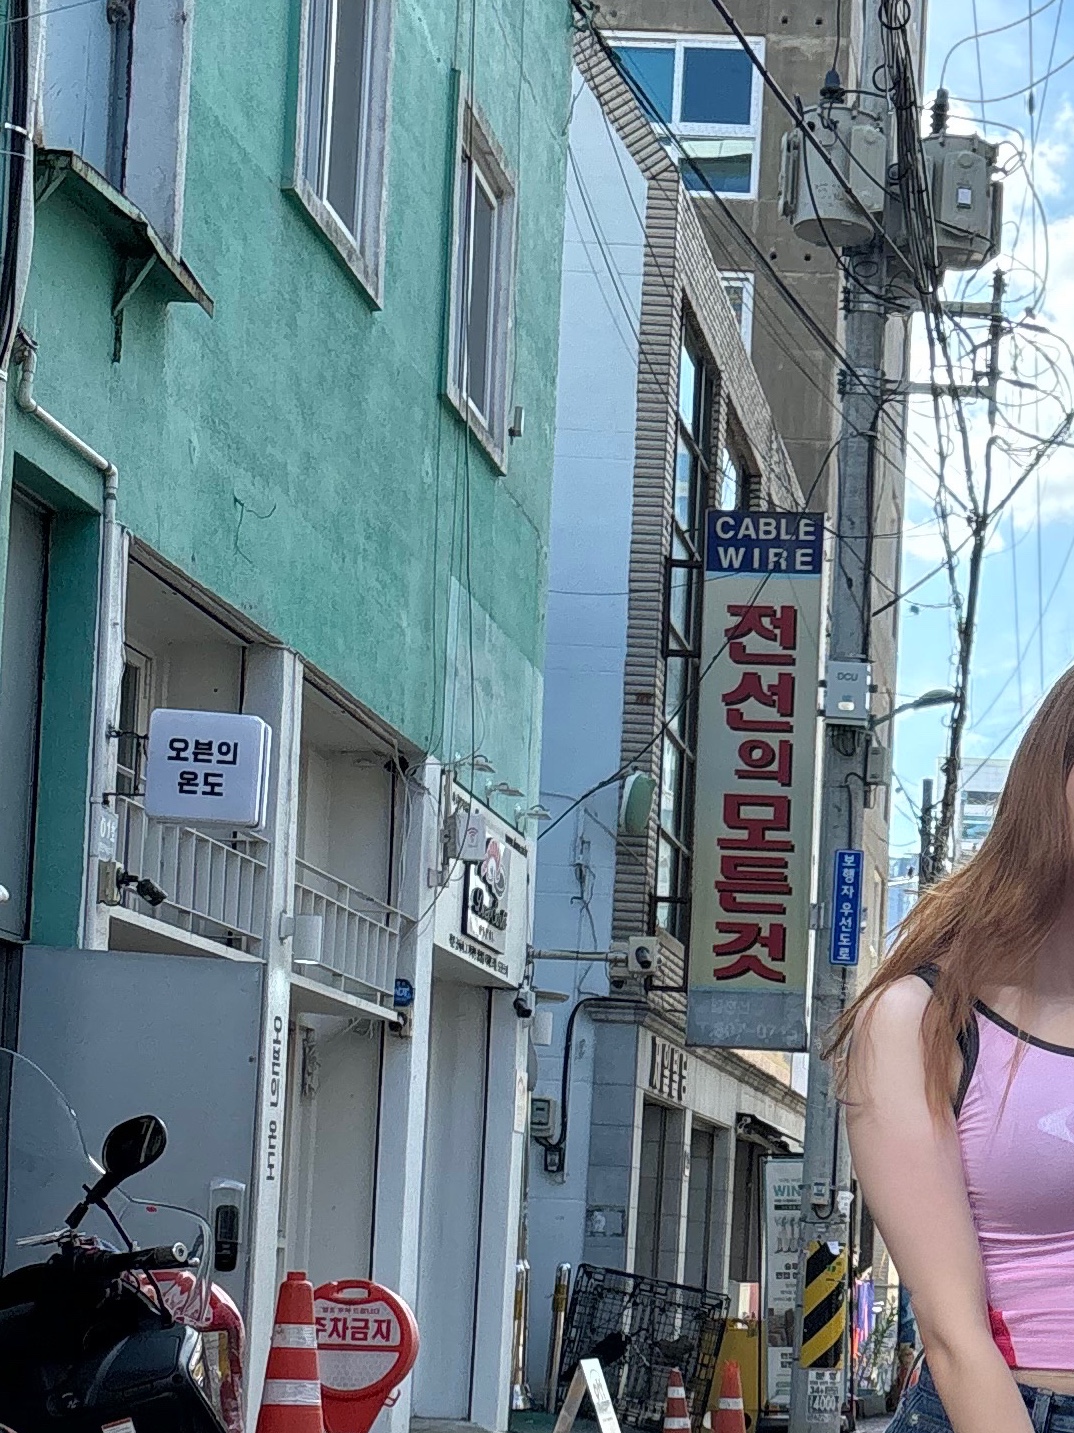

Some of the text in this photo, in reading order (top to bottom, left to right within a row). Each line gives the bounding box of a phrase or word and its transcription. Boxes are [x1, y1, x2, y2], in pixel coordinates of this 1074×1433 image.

[715, 516, 816, 541] CABLE
[717, 546, 814, 571] WIRE
[837, 671, 859, 682] DCU
[167, 737, 239, 766] 오븐의
[177, 770, 224, 797] 온도
[836, 854, 857, 960] 보행자 우선도로
